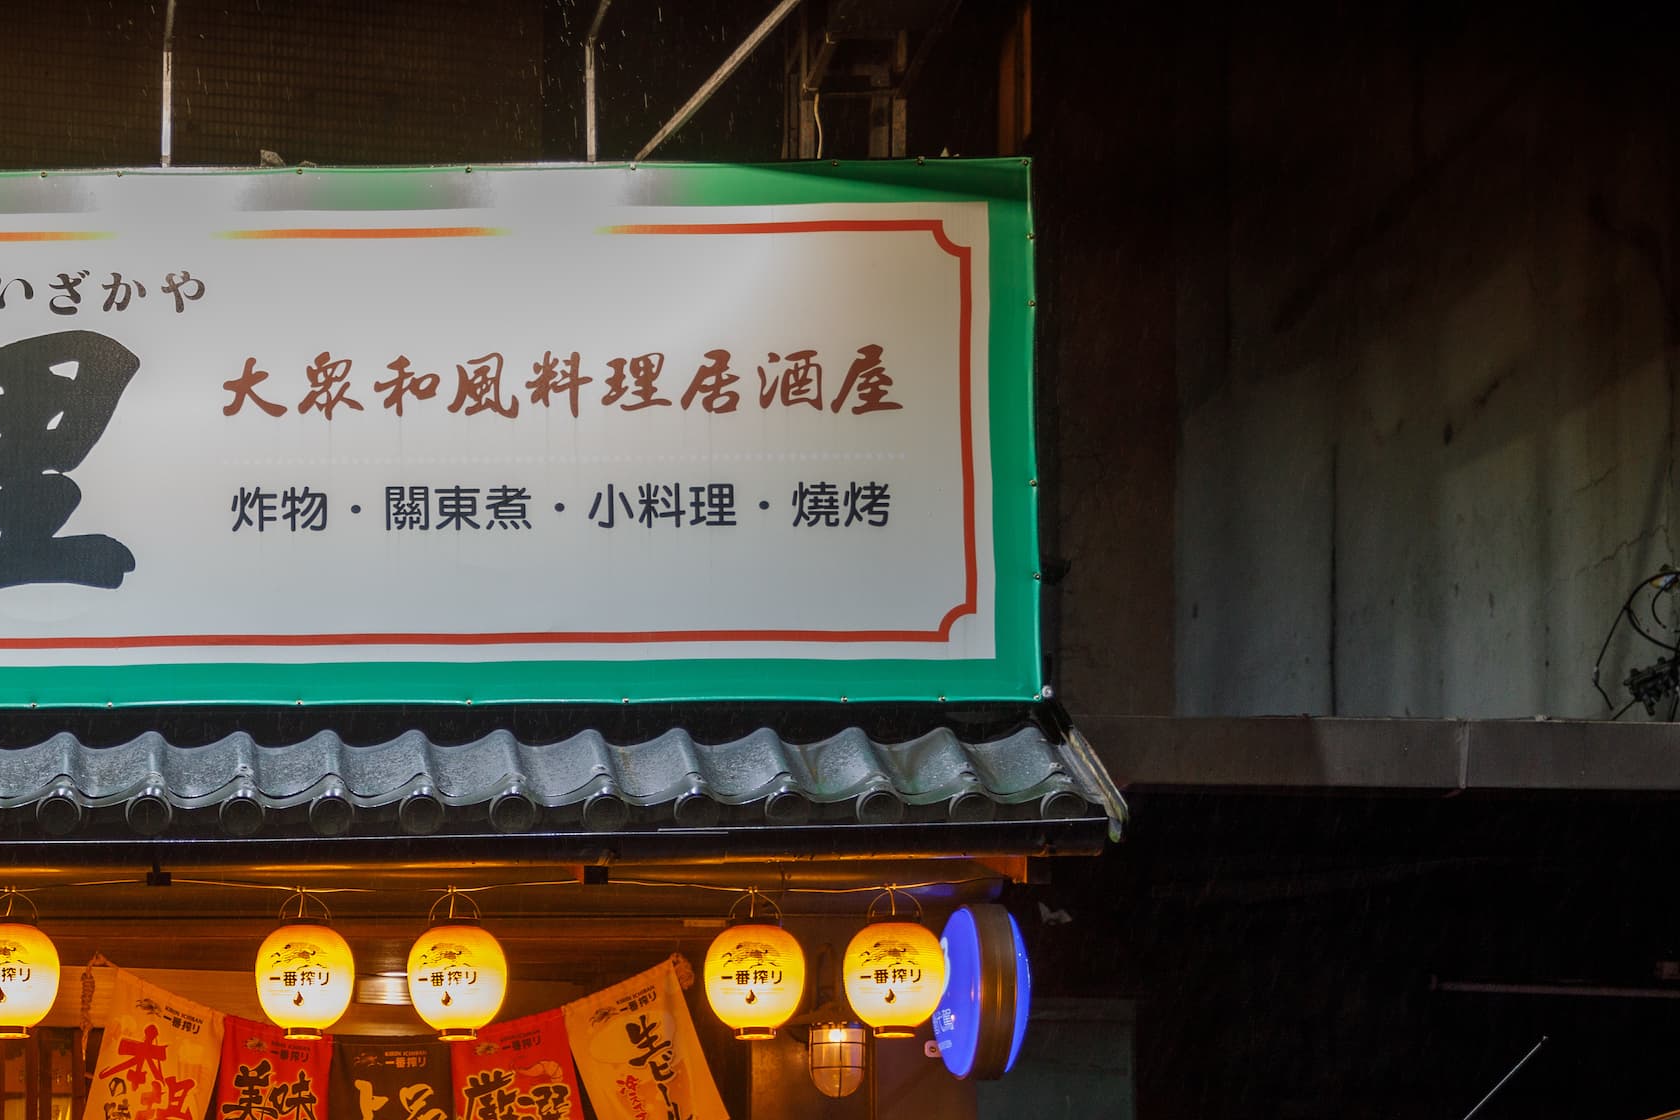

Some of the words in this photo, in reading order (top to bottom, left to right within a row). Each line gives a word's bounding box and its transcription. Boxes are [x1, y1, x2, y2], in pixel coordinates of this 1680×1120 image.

[269, 970, 330, 987] 一番搾り
[417, 970, 478, 987] 一番搾り
[721, 970, 784, 985] 一番搾り
[859, 968, 923, 985] 一番搾り
